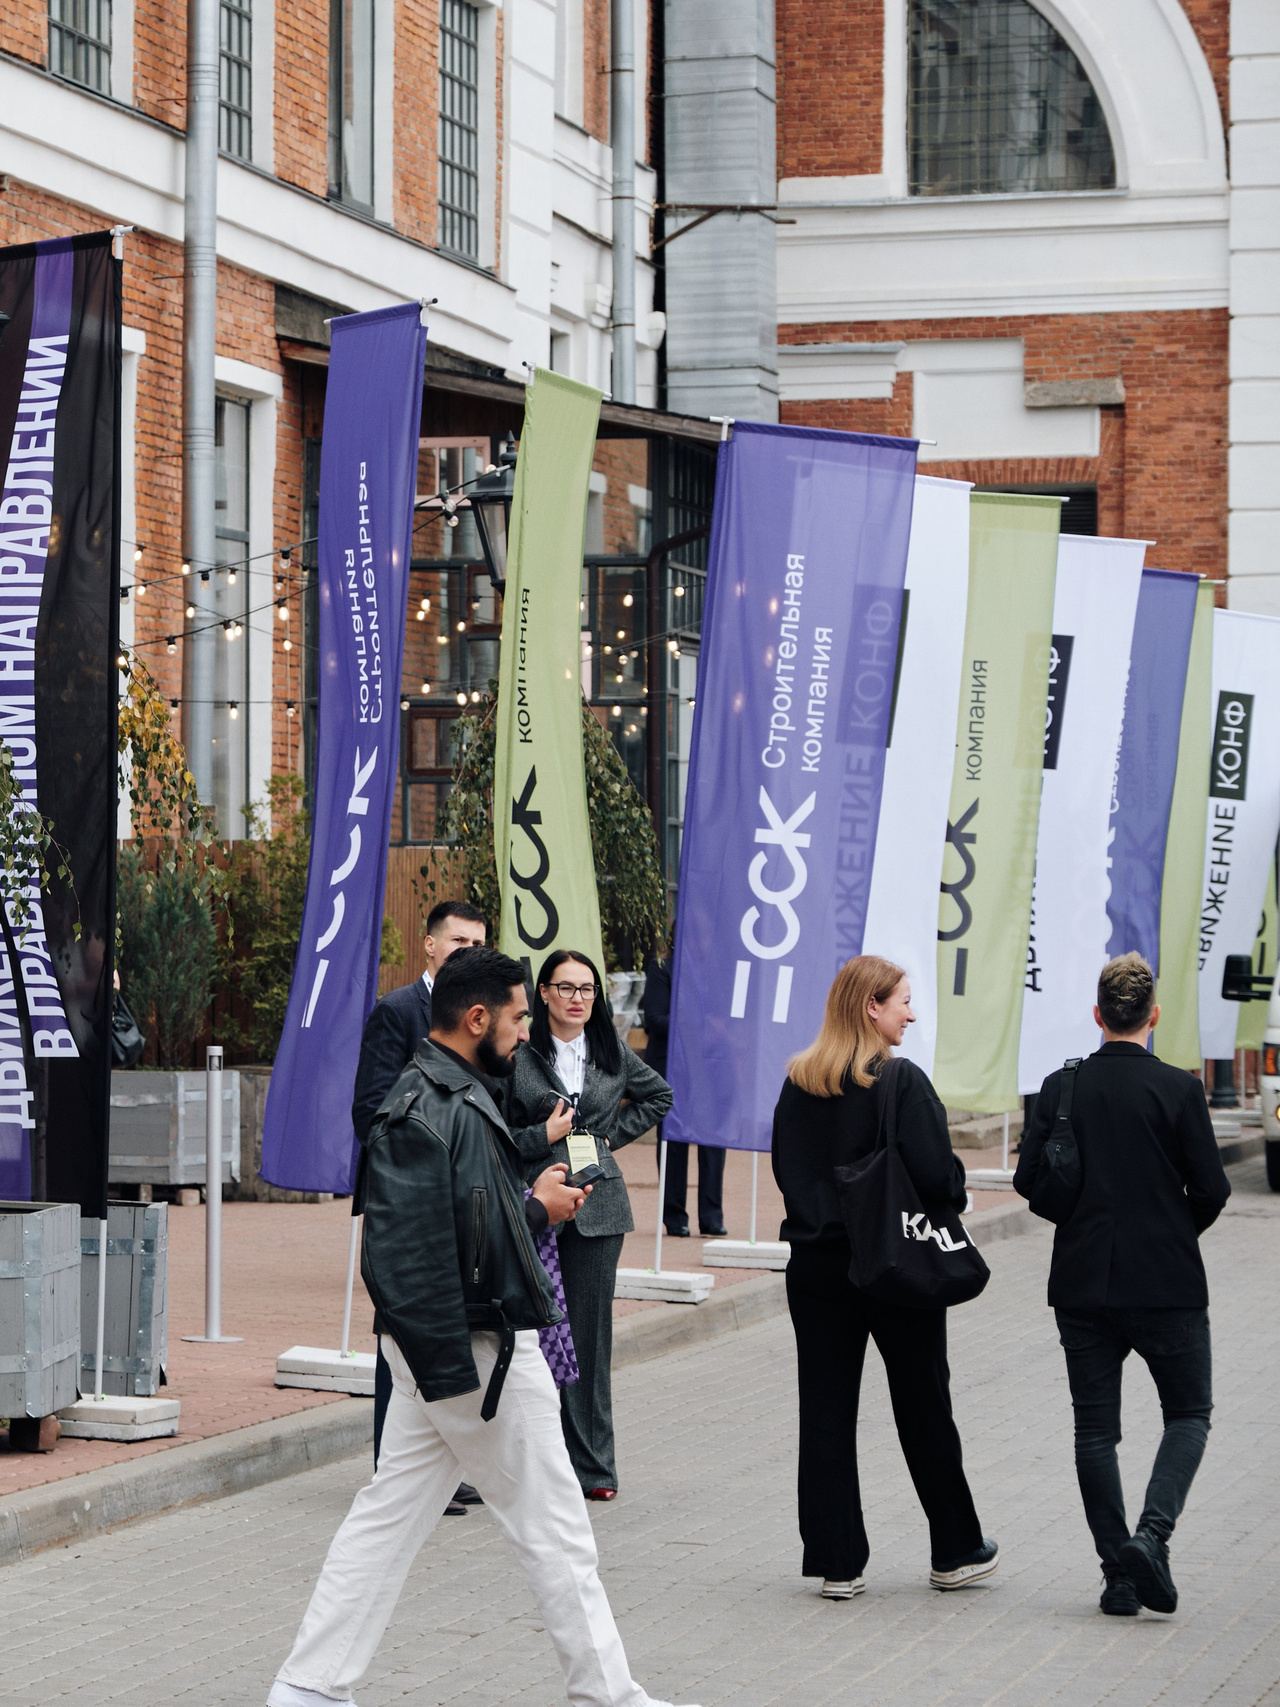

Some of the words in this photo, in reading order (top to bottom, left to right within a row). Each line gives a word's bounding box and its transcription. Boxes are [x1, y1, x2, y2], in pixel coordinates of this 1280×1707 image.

[761, 553, 805, 769] Строительная
[797, 627, 833, 773] компания
[964, 659, 989, 781] компания
[33, 1028, 80, 1058] В
